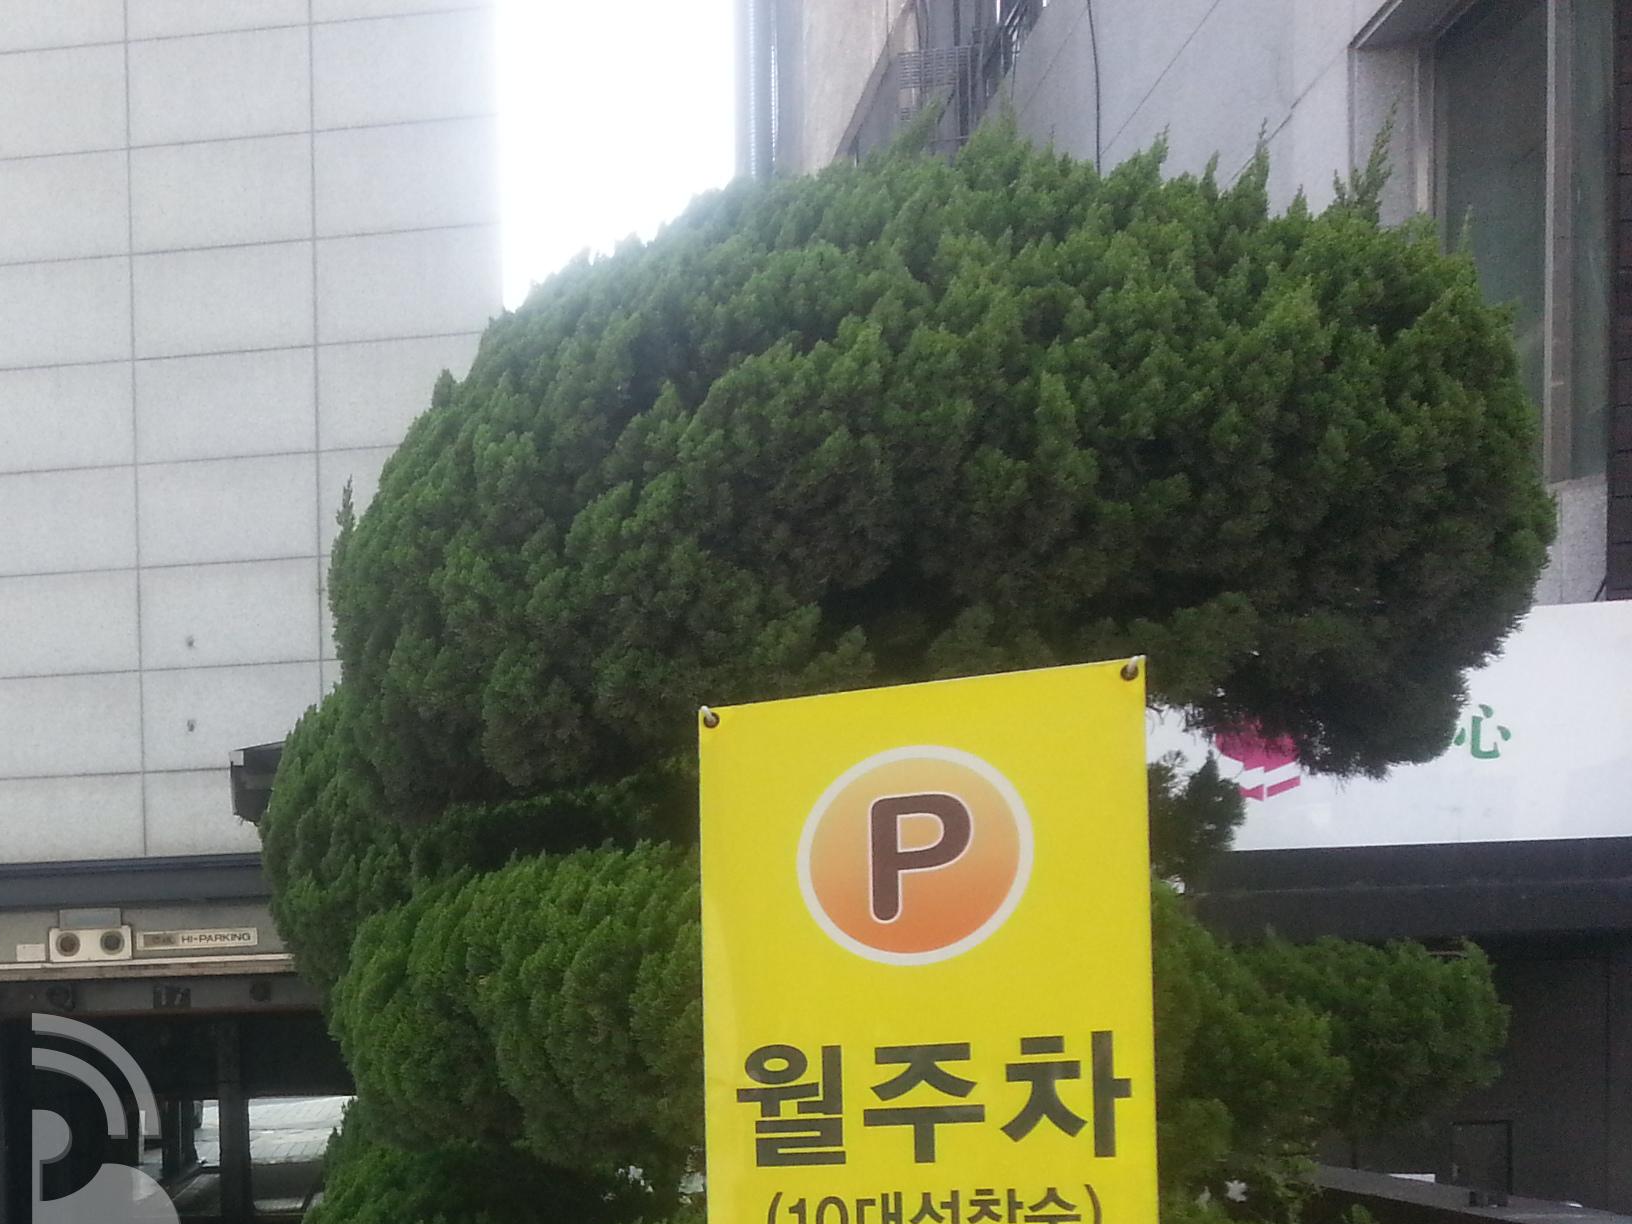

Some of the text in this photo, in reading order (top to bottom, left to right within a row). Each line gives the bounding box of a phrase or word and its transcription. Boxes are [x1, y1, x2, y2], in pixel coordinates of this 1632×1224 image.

[869, 791, 974, 923] P
[181, 932, 251, 944] HI-PARKING
[736, 1029, 1133, 1168] 월주차
